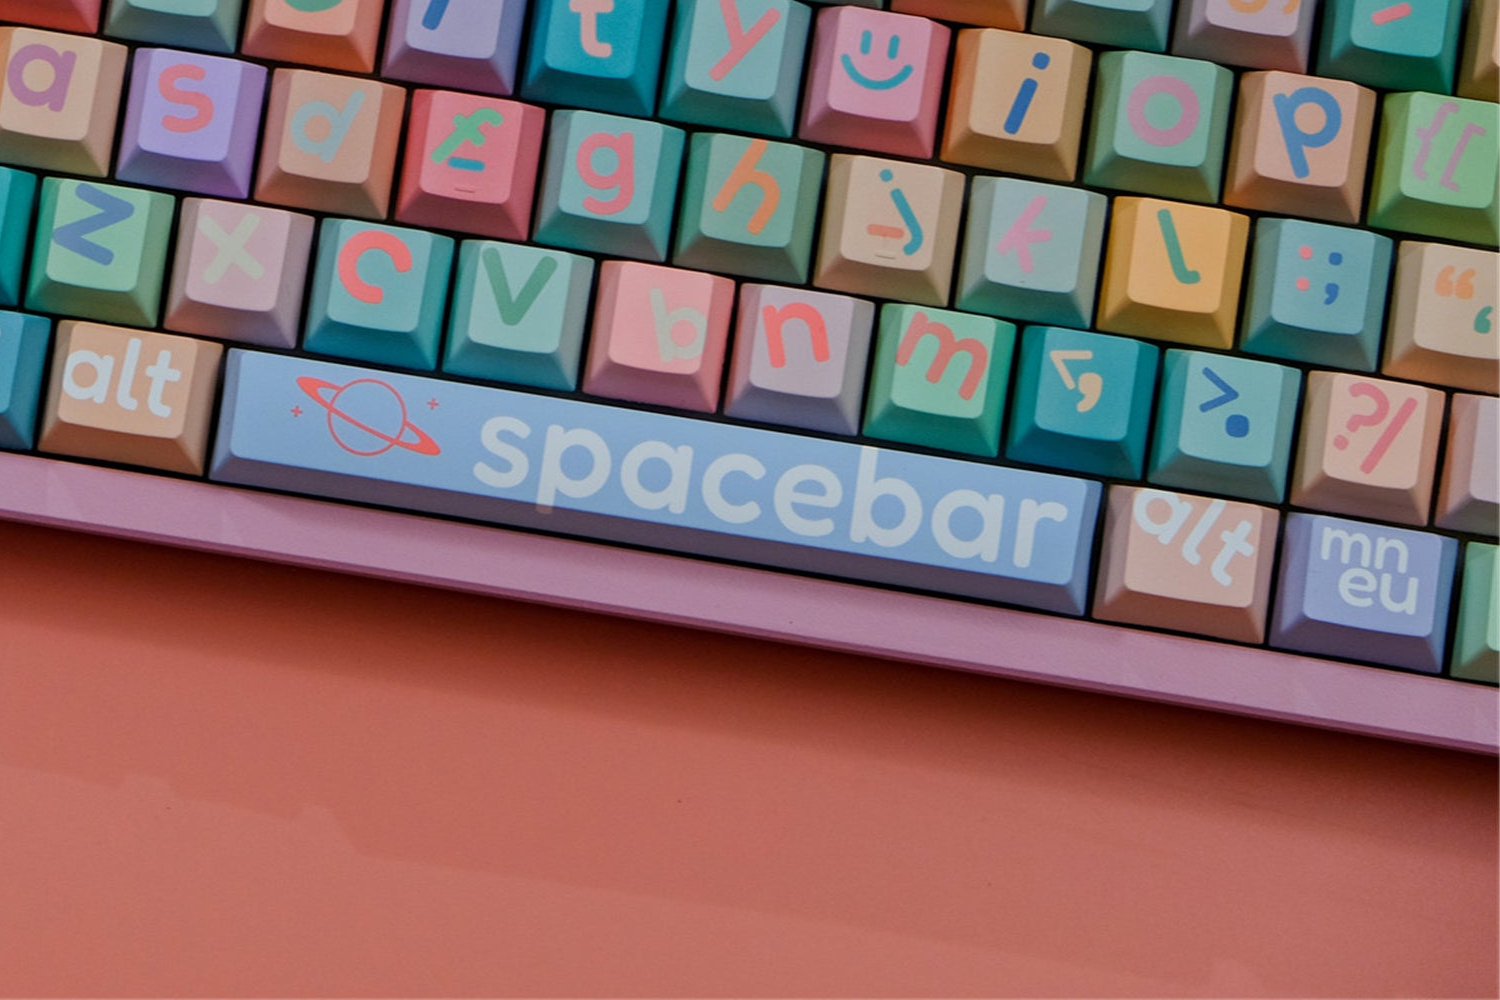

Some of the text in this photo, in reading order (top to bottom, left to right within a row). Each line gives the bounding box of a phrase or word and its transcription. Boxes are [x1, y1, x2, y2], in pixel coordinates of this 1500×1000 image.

[7, 43, 78, 113] a
[1004, 52, 1051, 135] i
[290, 89, 366, 163] d
[1272, 86, 1342, 179] p
[576, 131, 634, 215] g
[711, 139, 781, 236] h
[649, 287, 708, 363] b
[762, 302, 830, 369] n
[895, 311, 989, 402] m
[62, 337, 182, 419] alt
[473, 416, 1069, 568] spacebar
[1132, 489, 1255, 587] alt
